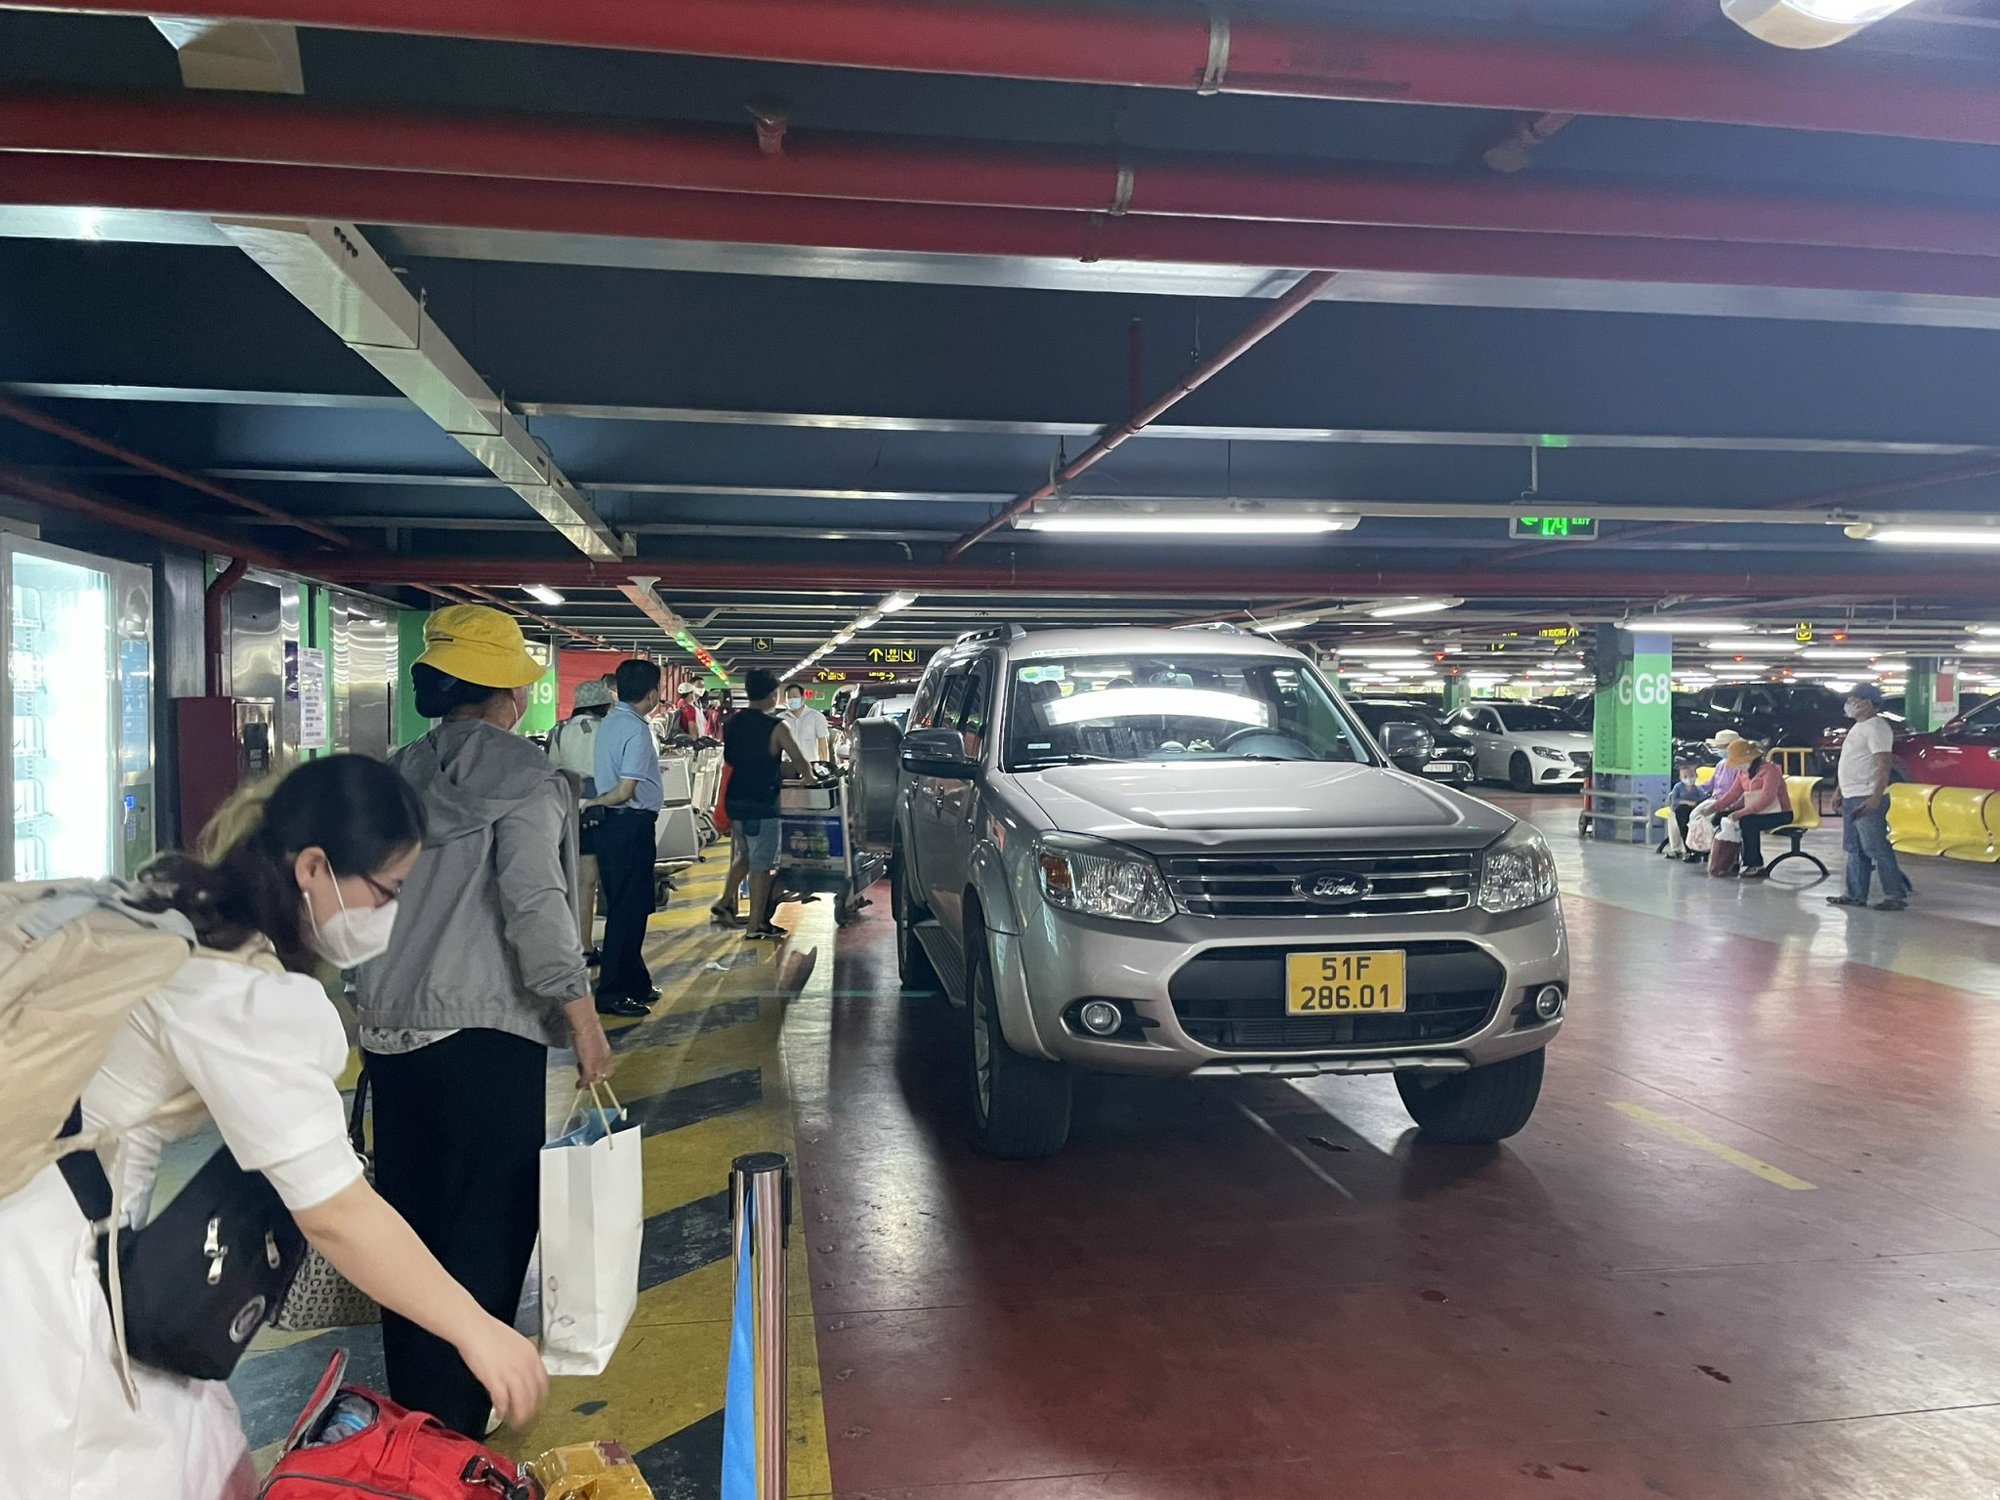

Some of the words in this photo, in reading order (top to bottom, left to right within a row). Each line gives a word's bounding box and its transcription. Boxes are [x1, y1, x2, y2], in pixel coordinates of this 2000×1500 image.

[1635, 672, 1669, 705] G8
[1313, 877, 1358, 895] Ford
[1322, 957, 1371, 981] 51F
[1301, 984, 1389, 1010] 286.01
